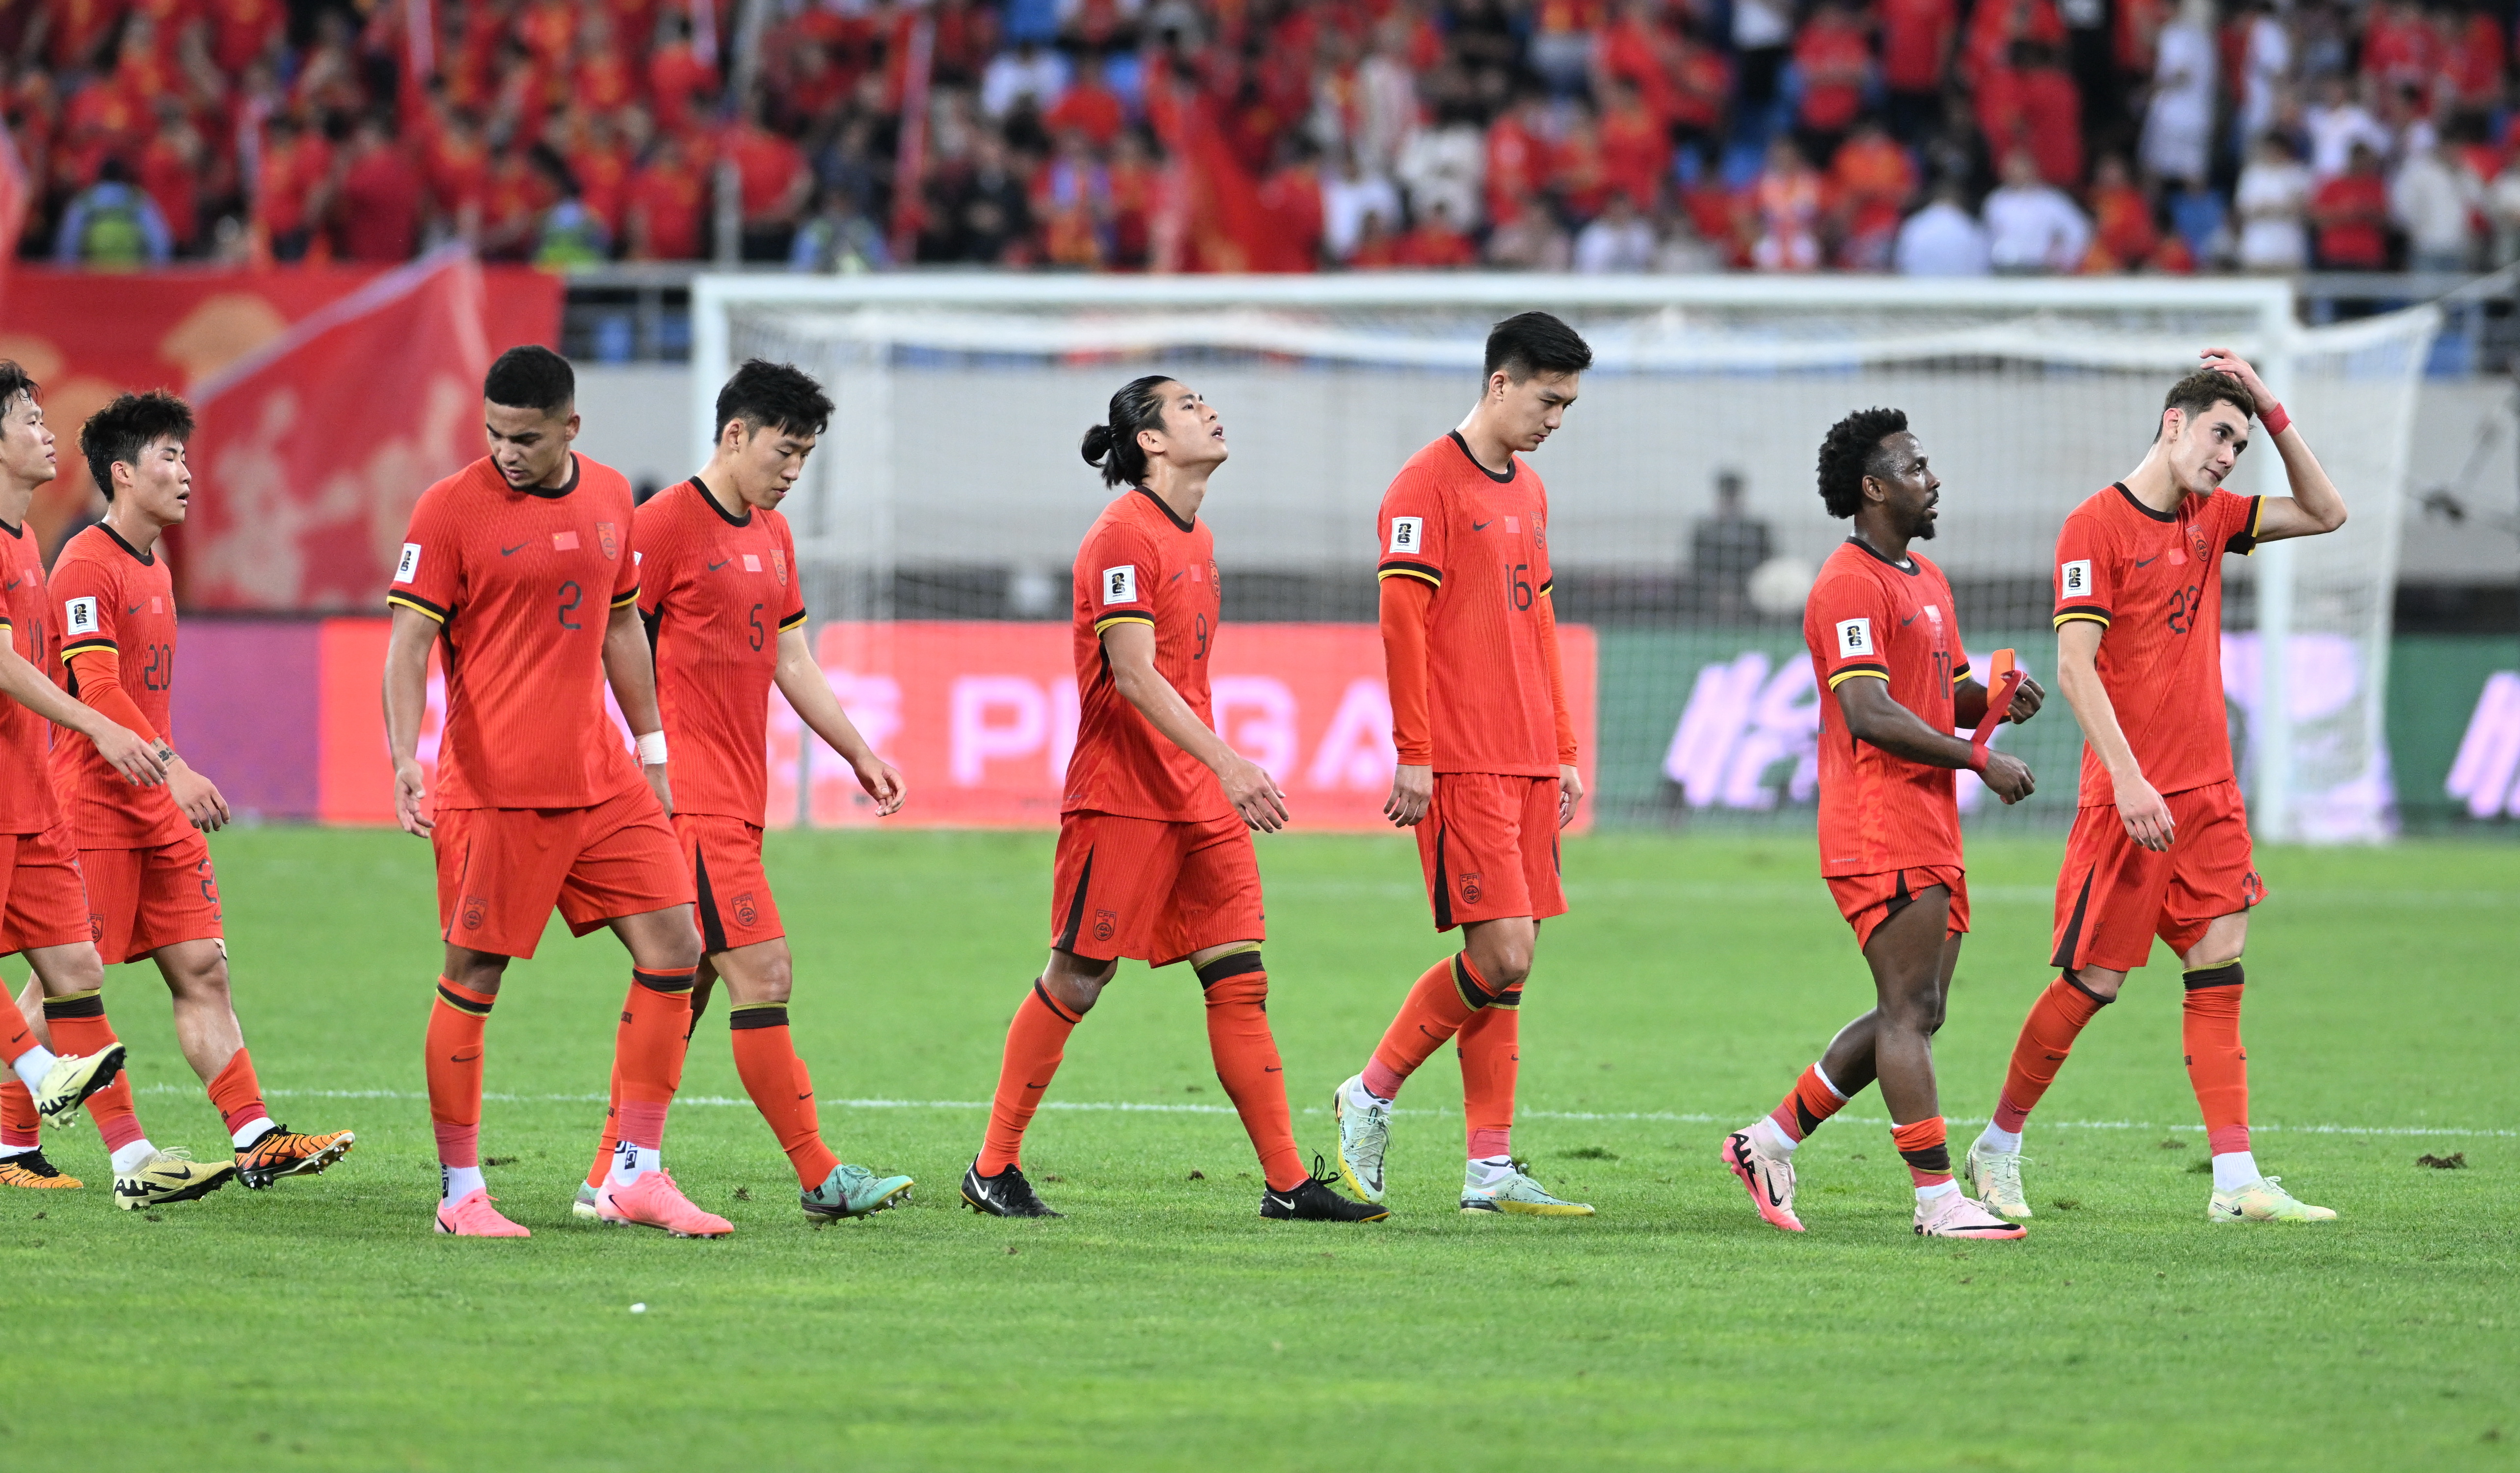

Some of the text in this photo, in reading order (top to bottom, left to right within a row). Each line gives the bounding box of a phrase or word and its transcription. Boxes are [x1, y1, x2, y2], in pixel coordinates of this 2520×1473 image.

[558, 580, 583, 630] 2
[1505, 564, 1532, 611] 16
[28, 618, 44, 665] 10
[749, 604, 764, 652] 5
[1193, 613, 1207, 660] 9
[144, 644, 171, 690] 20
[1932, 651, 1951, 699] 17
[114, 1178, 175, 1200] AIR
